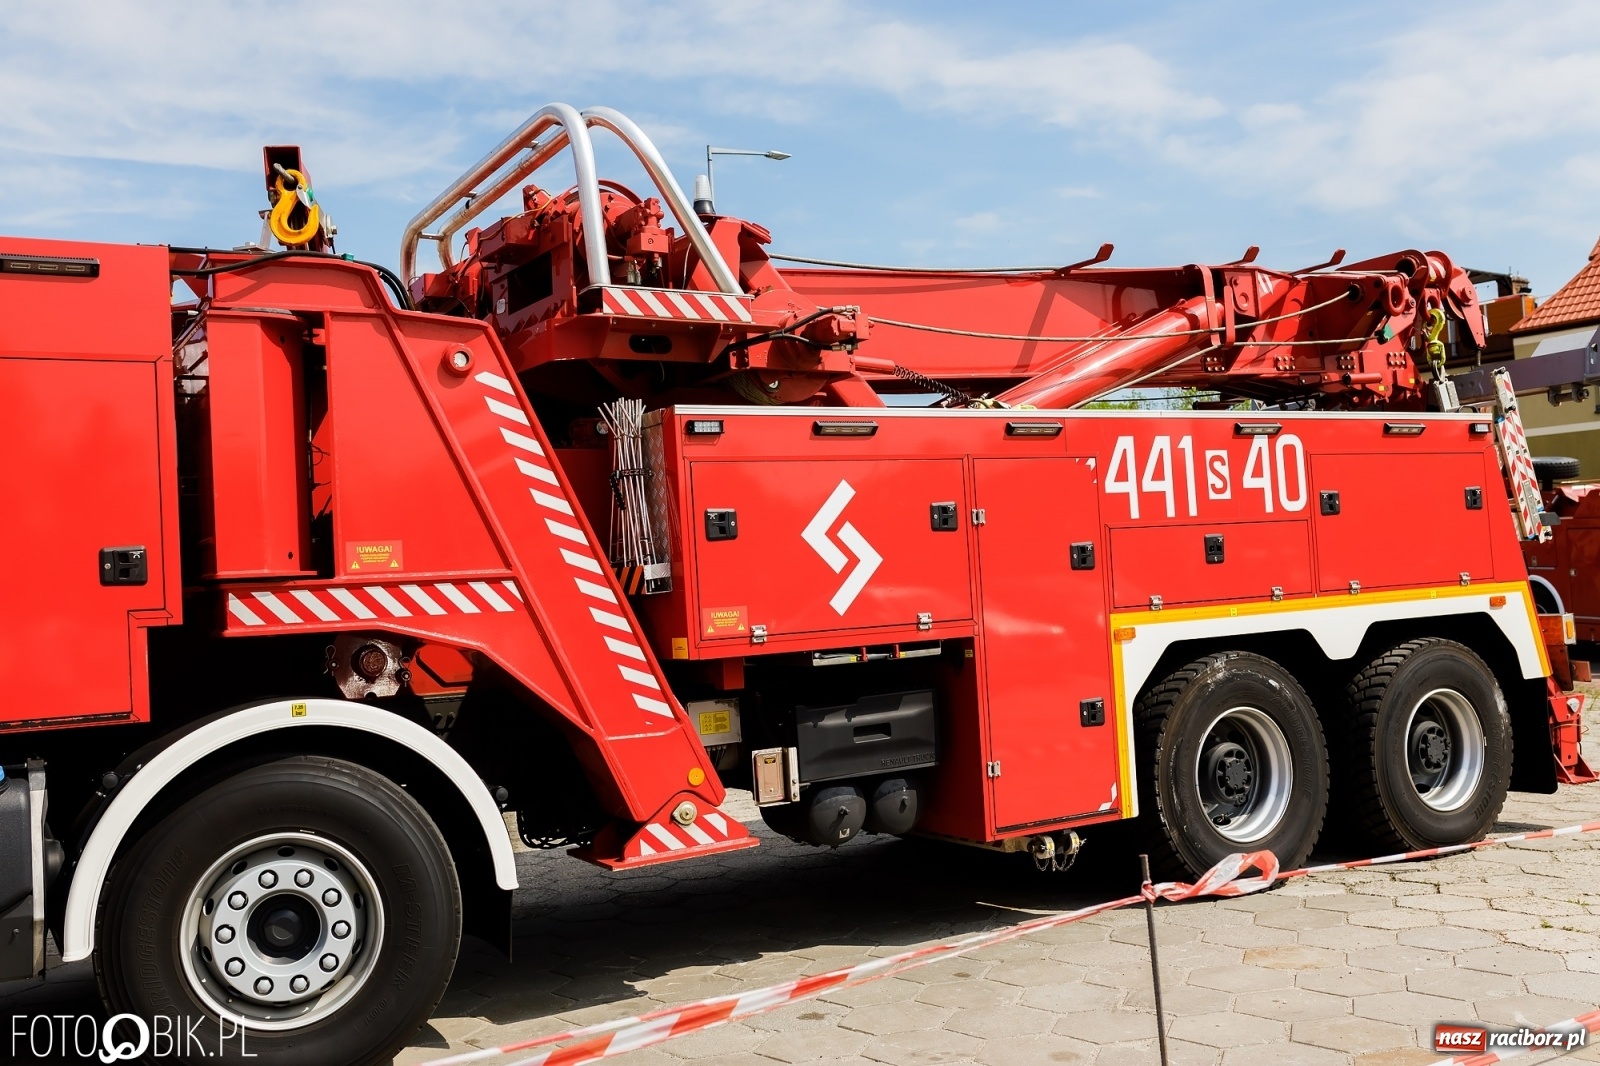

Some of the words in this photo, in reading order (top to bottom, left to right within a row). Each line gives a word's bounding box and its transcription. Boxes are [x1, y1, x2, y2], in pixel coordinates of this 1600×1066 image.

[1104, 435, 1198, 519] 441
[1207, 453, 1229, 496] S
[1242, 434, 1308, 513] 40
[880, 754, 911, 767] RENAULT
